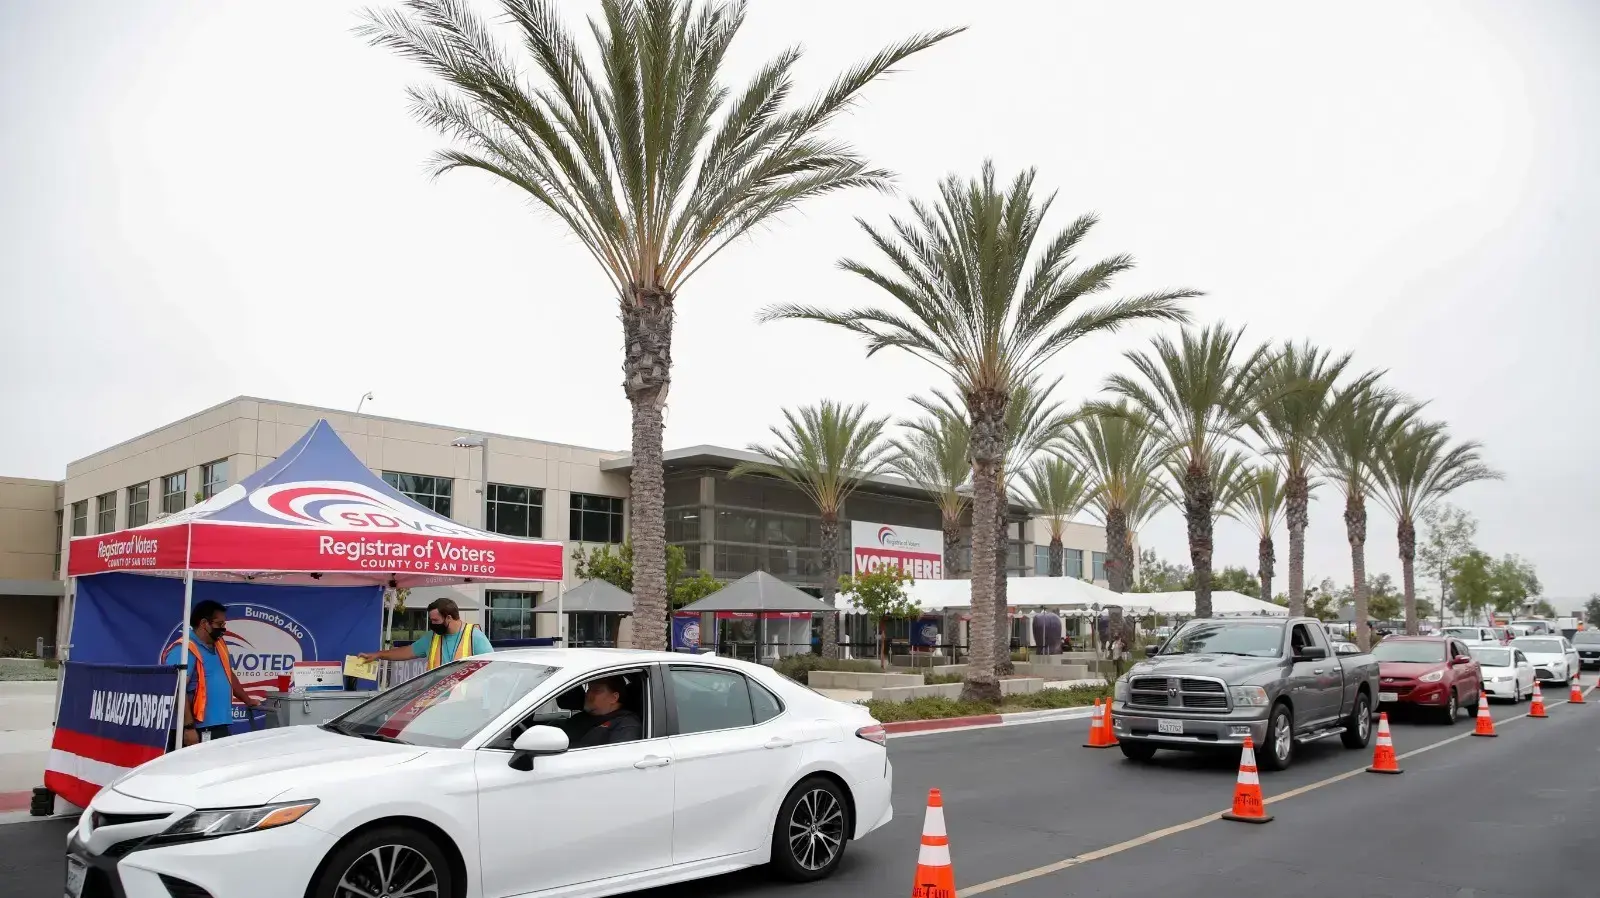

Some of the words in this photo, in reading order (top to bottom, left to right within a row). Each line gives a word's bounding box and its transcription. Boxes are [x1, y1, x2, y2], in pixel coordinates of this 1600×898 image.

[97, 538, 126, 562] Registrar
[126, 535, 136, 554] of
[135, 535, 158, 554] Voters
[107, 557, 124, 568] COUNTY
[124, 557, 131, 567] OF
[131, 557, 140, 566] SAN
[141, 556, 157, 566] DIEGO
[319, 535, 411, 561] Registrar
[413, 539, 434, 559] of
[436, 541, 496, 563] Voters
[360, 559, 411, 569] COUNTY
[414, 561, 430, 570] OF
[434, 562, 457, 572] SAN
[461, 564, 496, 574] DIEGO
[855, 553, 899, 575] VOTE
[902, 557, 941, 580] HERE
[245, 606, 284, 626] Bumoto
[284, 620, 304, 639] Ako
[229, 653, 296, 671] VOTED
